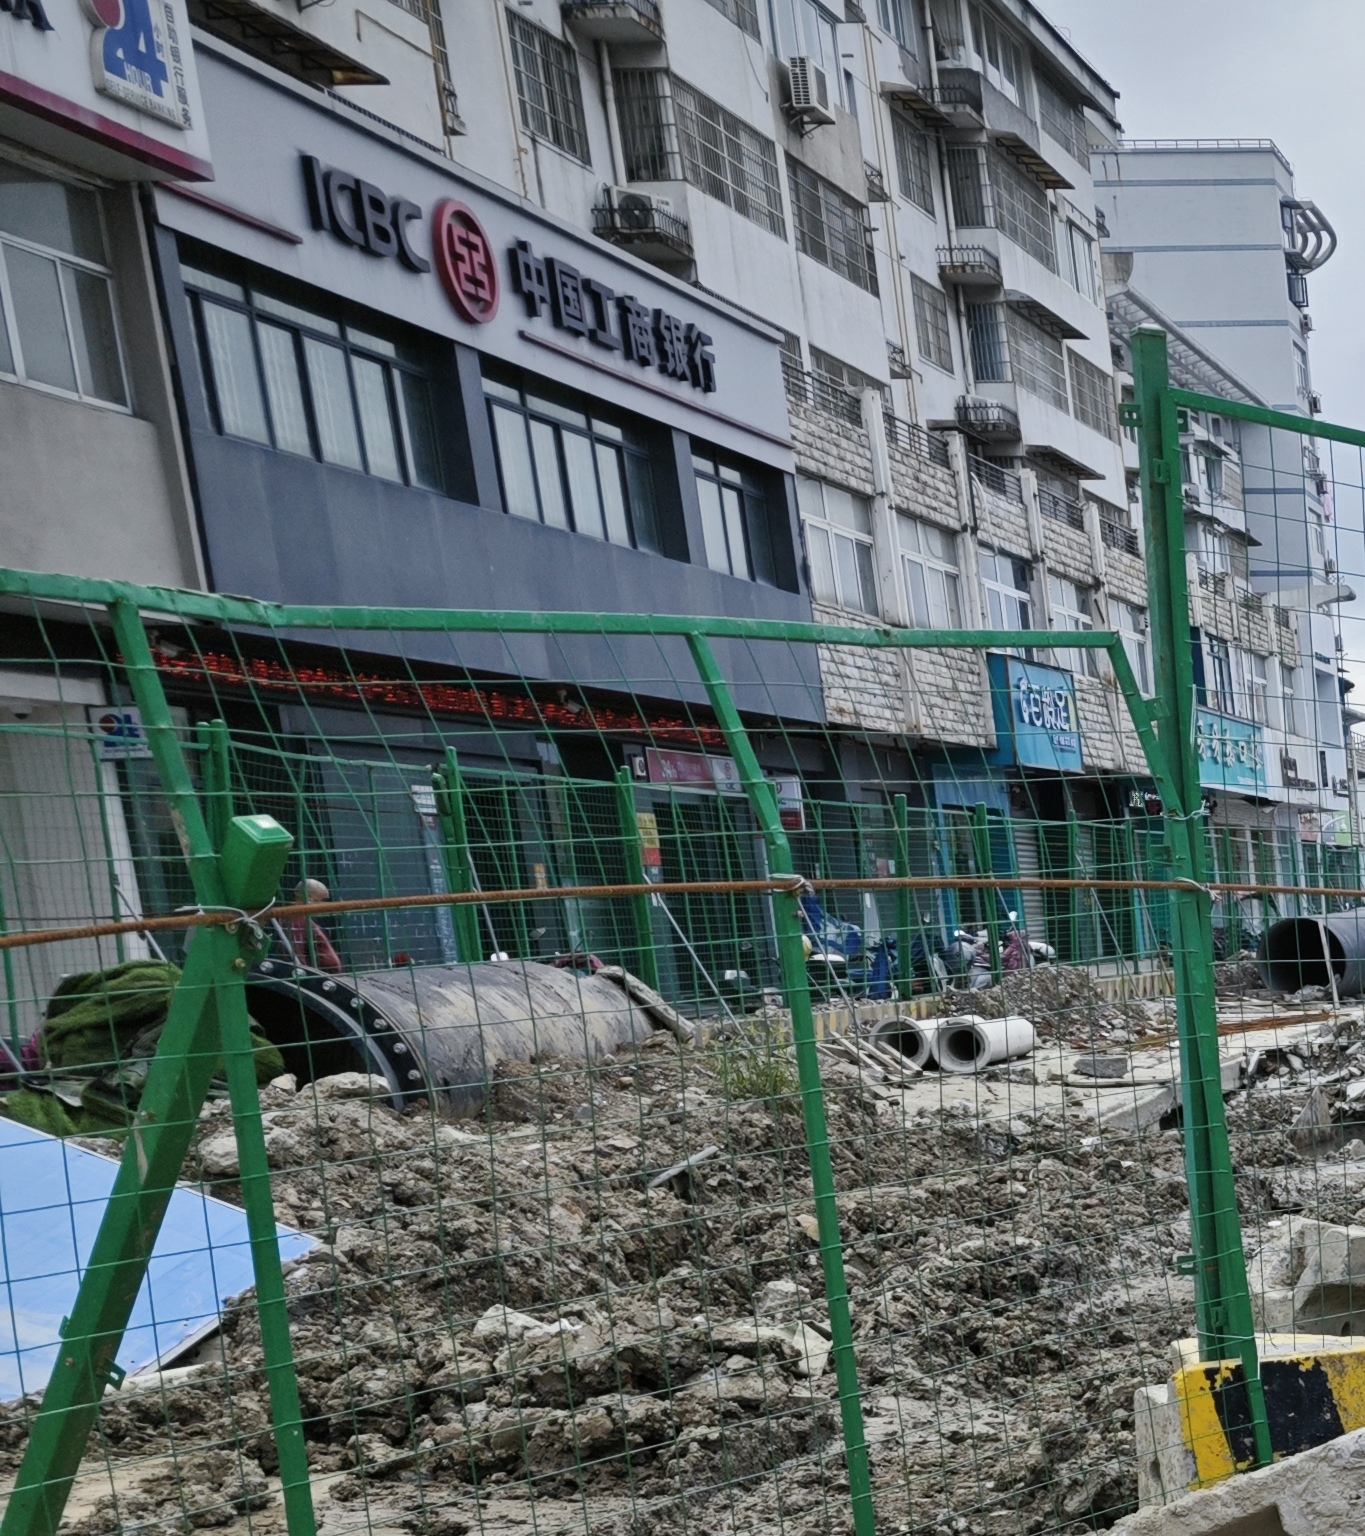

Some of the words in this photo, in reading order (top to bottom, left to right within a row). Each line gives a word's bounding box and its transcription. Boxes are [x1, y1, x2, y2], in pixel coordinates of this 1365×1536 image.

[124, 61, 153, 94] HOUR
[300, 153, 431, 274] ICBC
[508, 239, 717, 393] 中国工商银行
